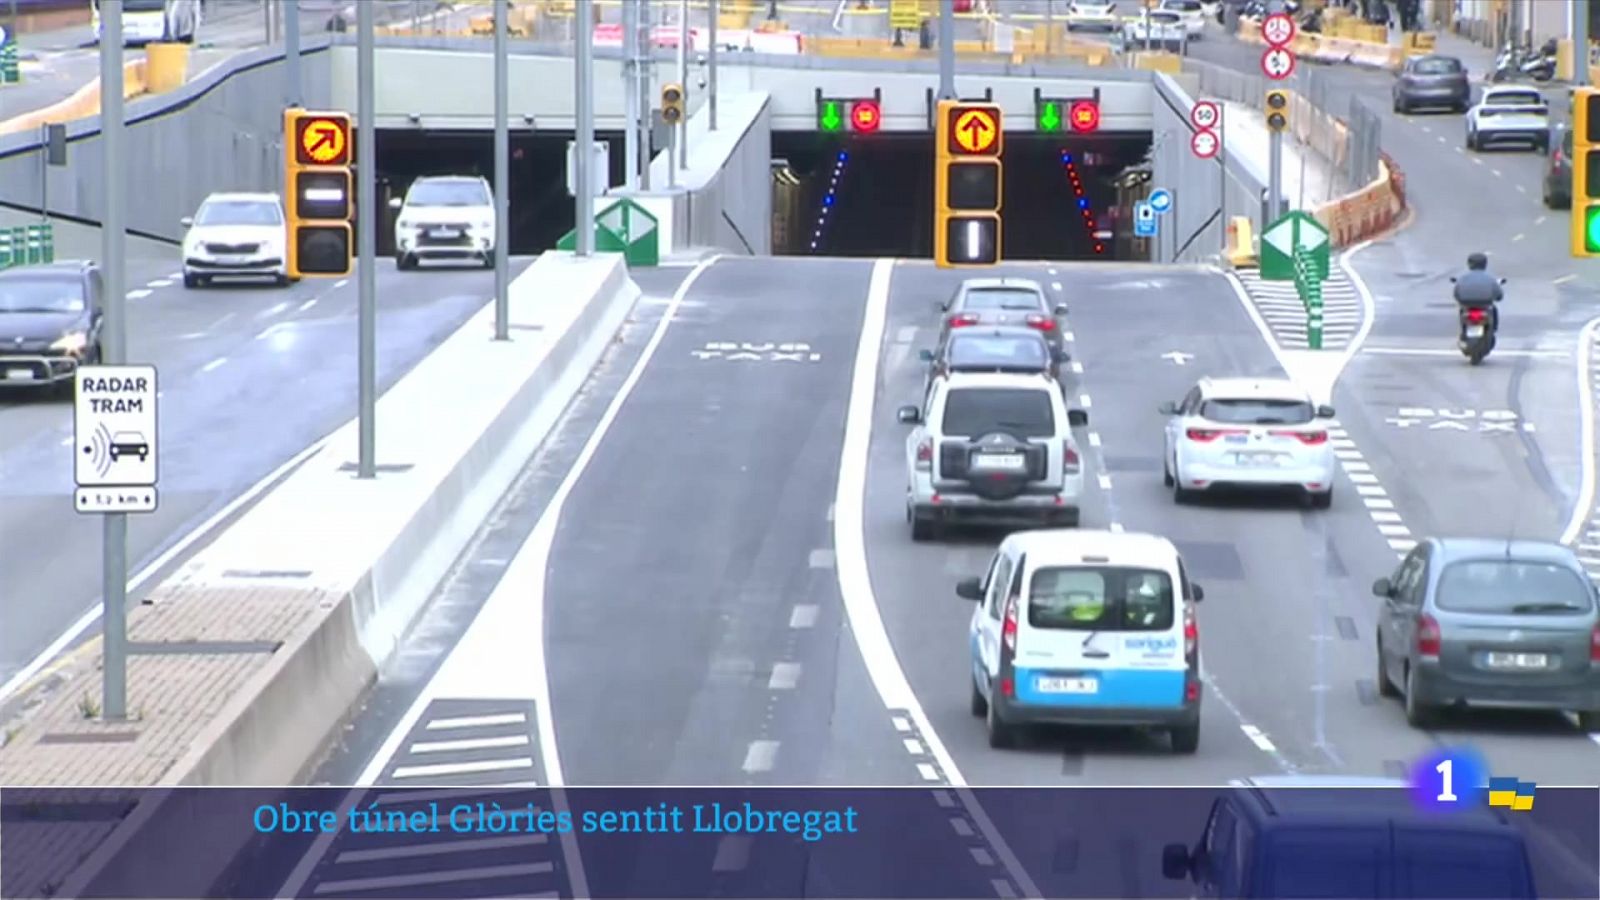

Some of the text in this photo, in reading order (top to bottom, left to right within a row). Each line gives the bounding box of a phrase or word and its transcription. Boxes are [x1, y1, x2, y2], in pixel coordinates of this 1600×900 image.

[1198, 110, 1212, 121] 50
[706, 342, 811, 351] BUS
[691, 351, 821, 361] TAXI
[82, 377, 148, 393] RADAR
[90, 398, 143, 413] TRAM
[1385, 418, 1536, 433] TAXI
